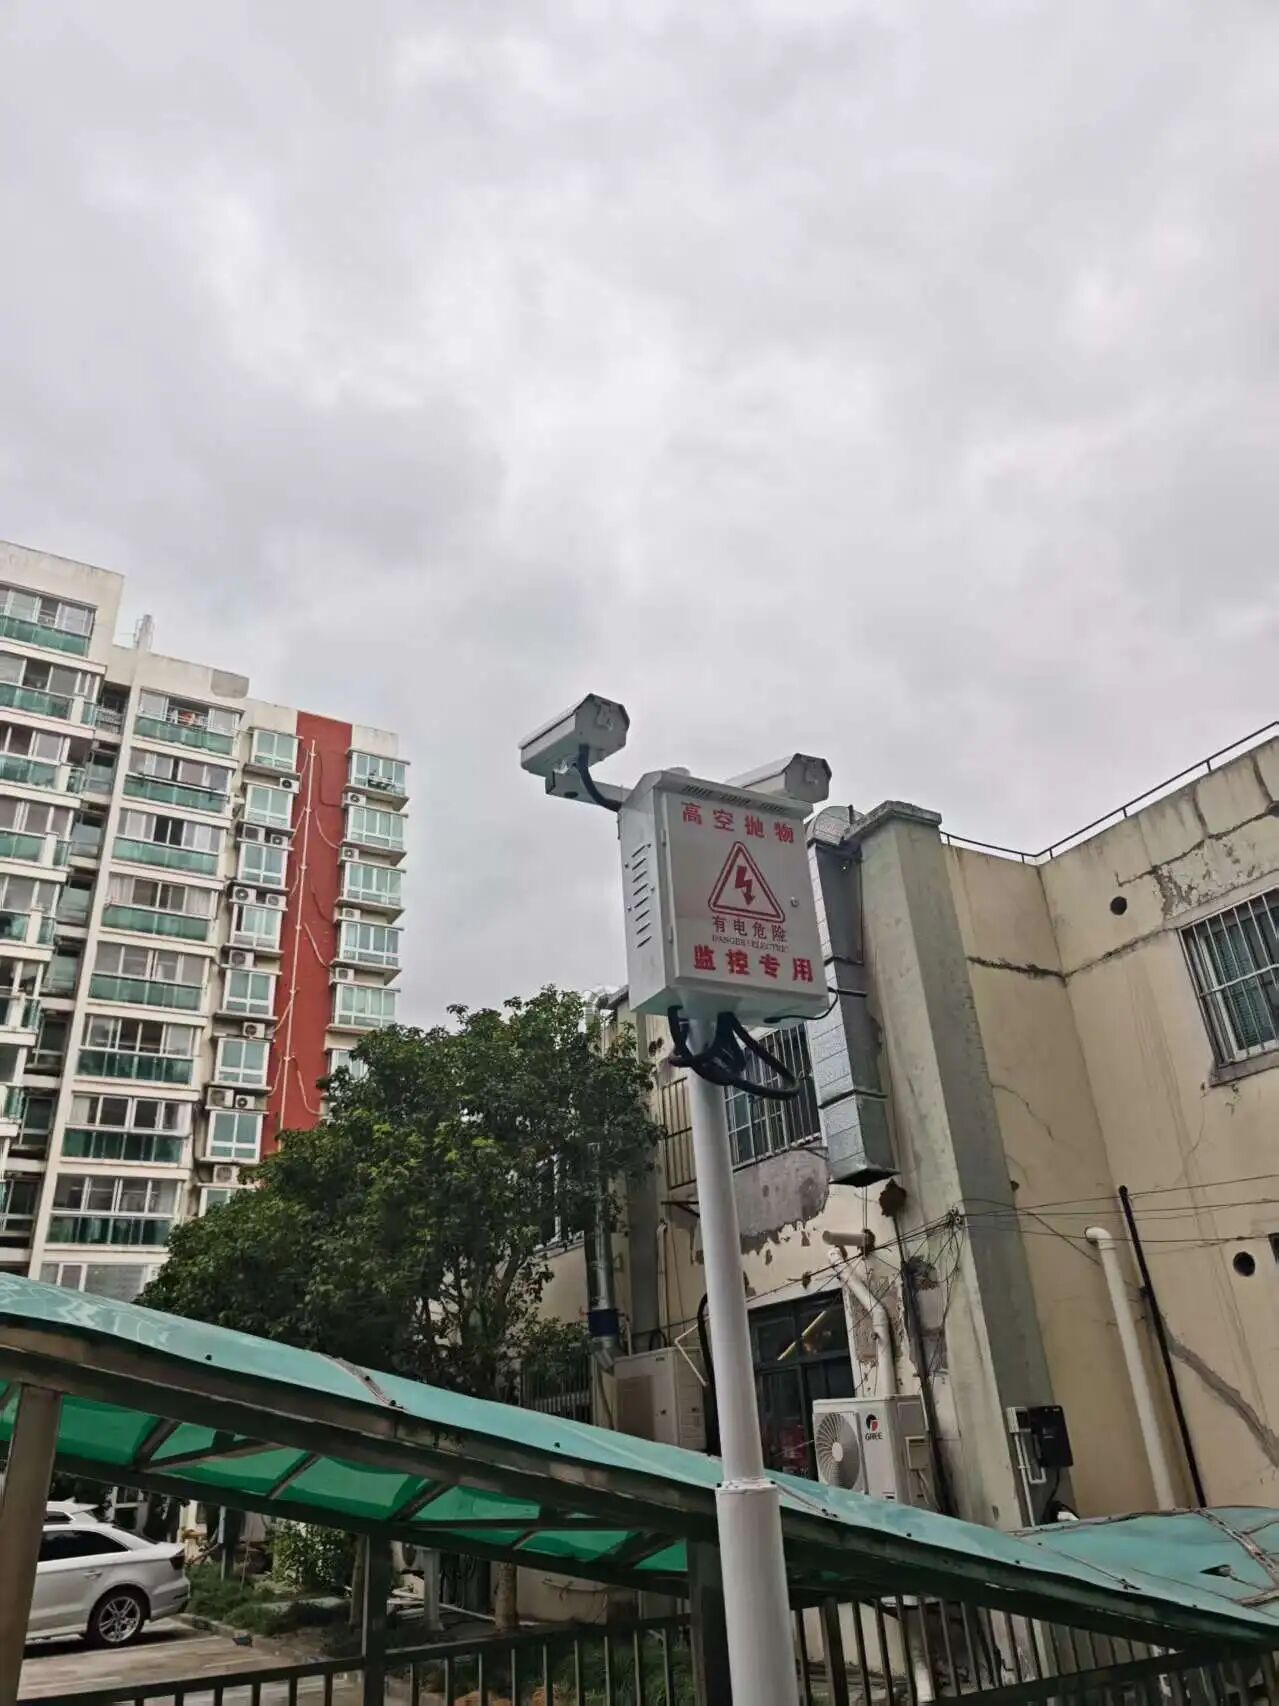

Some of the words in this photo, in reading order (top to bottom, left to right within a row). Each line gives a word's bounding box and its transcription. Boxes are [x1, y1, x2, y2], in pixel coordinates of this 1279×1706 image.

[681, 801, 795, 843] 高空抛物
[712, 915, 786, 942] 有电危险
[694, 944, 813, 982] 监控专用
[865, 1432, 883, 1440] GREE
